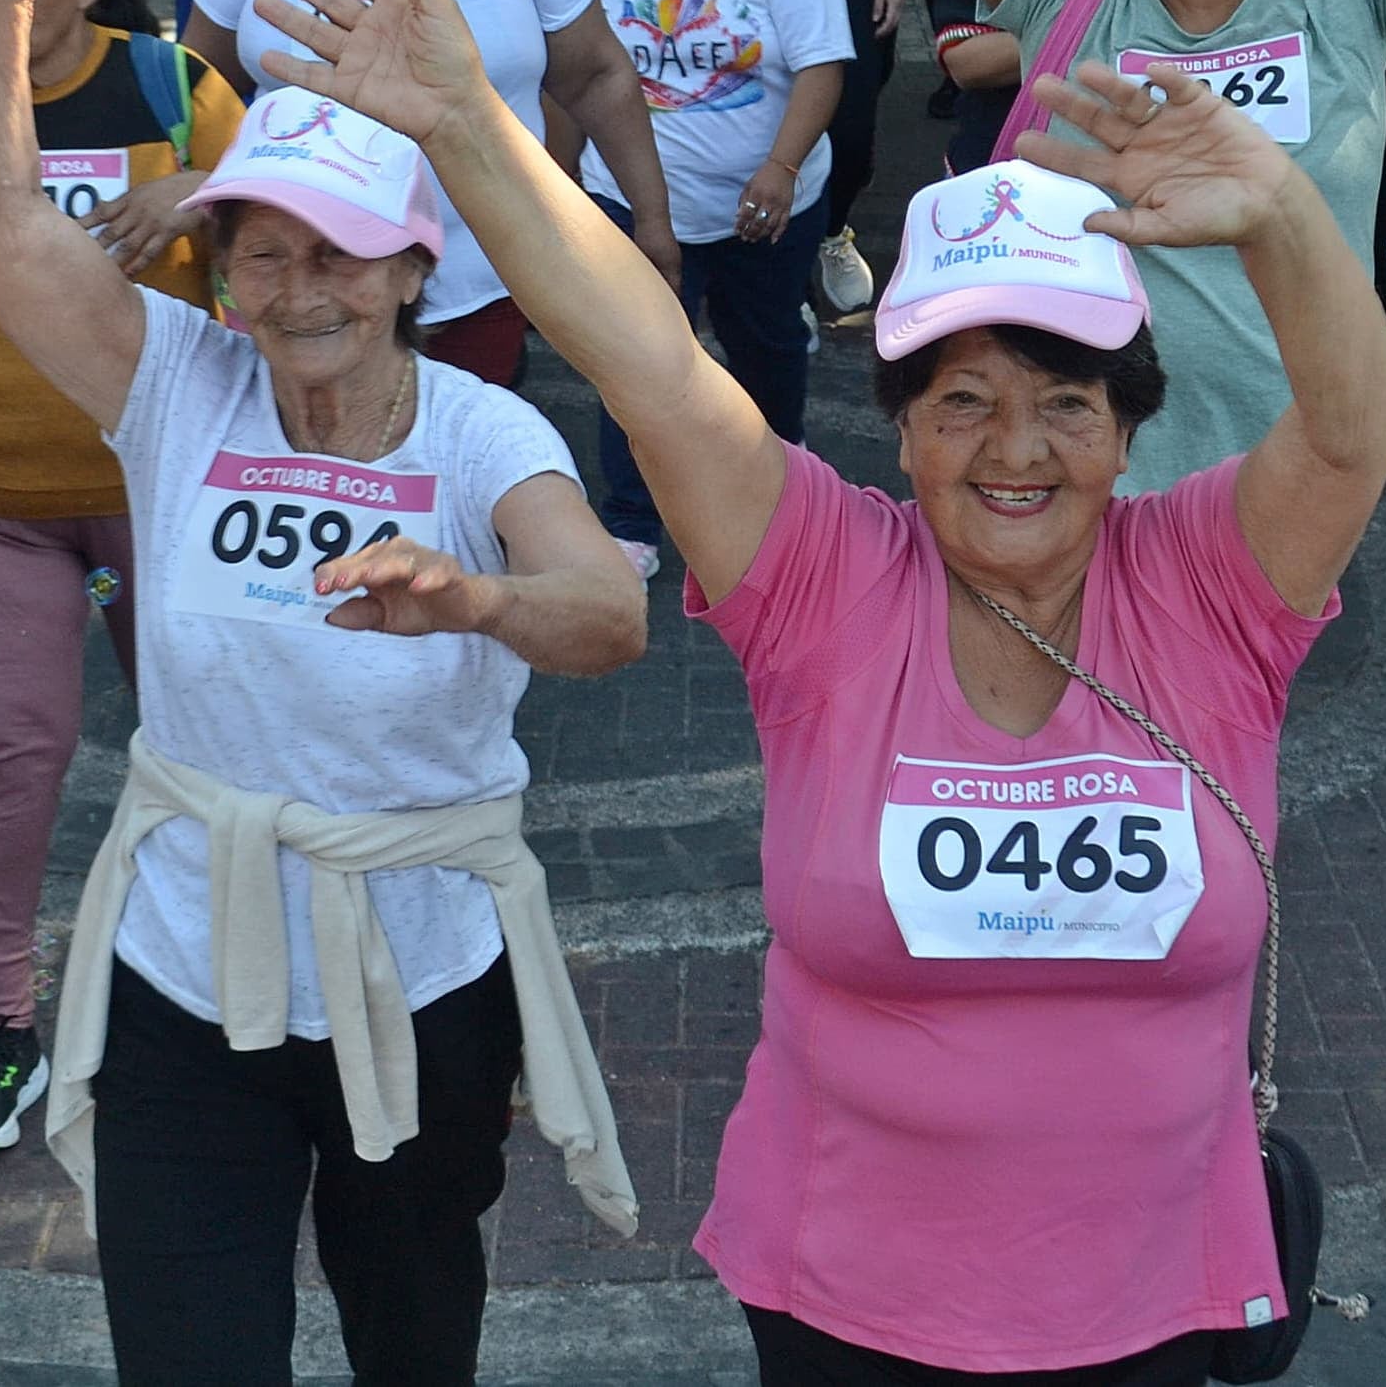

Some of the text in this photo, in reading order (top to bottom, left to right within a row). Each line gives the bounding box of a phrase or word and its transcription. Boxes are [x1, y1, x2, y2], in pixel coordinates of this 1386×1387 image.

[1225, 48, 1271, 67] ROSA
[48, 160, 95, 175] ROSA
[932, 236, 1009, 272] Maipú
[239, 467, 398, 505] OCTUBRE ROSA
[244, 581, 307, 607] Maipú
[931, 772, 1139, 803] OCTUBRE ROSA
[916, 814, 1169, 894] 0465
[978, 908, 1055, 935] Maipú
